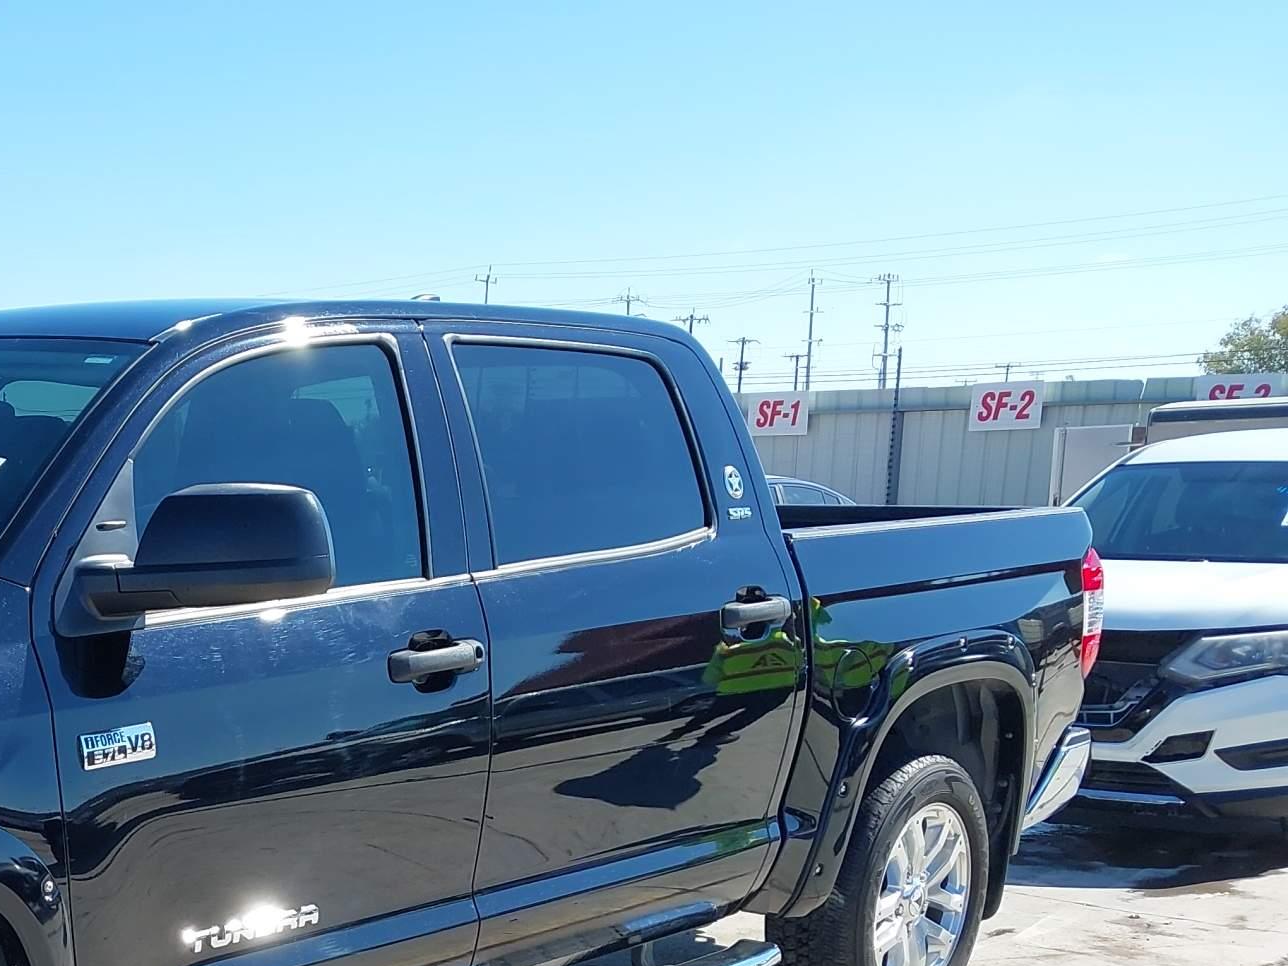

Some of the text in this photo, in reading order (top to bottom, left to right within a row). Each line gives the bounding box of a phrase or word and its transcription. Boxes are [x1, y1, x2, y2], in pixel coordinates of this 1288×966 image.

[756, 400, 801, 428] SF-1
[977, 390, 1036, 422] SF-2
[127, 731, 154, 753] V8
